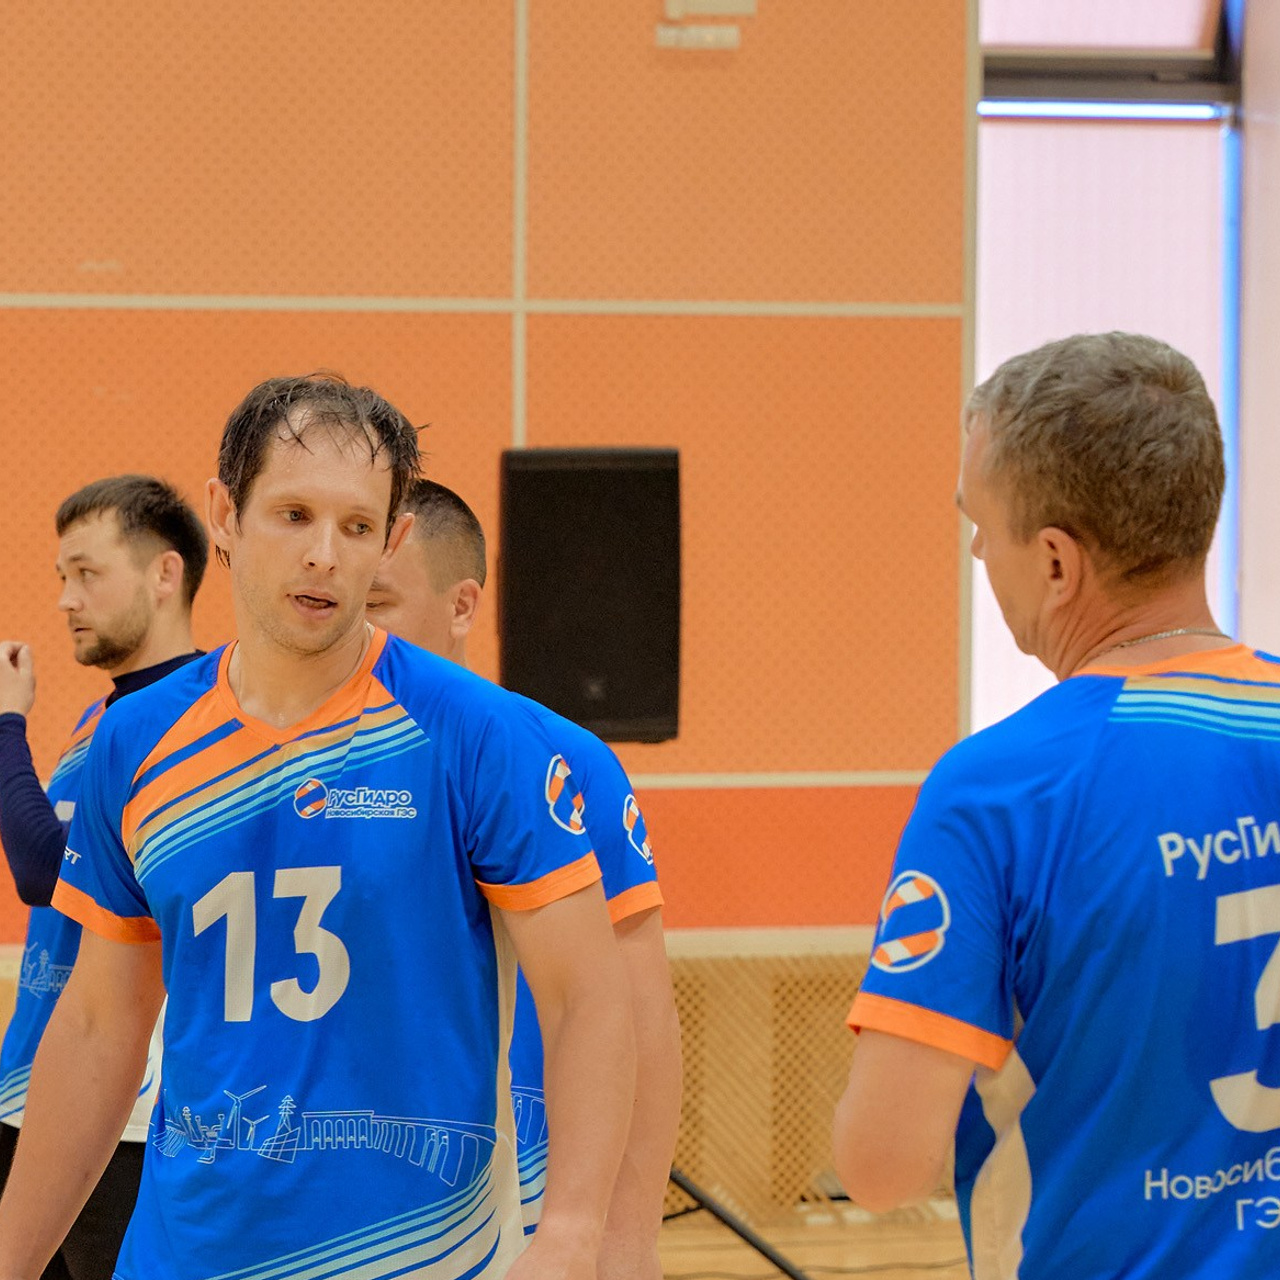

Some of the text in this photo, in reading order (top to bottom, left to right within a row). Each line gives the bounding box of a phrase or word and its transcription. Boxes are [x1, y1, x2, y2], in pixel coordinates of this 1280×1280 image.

[327, 787, 412, 808] РусГидро
[395, 807, 418, 819] ГЭС
[1157, 815, 1280, 880] РусГи
[192, 864, 350, 1023] 13
[1144, 1145, 1280, 1201] Новосиб
[1236, 1195, 1280, 1231] ГЭ
